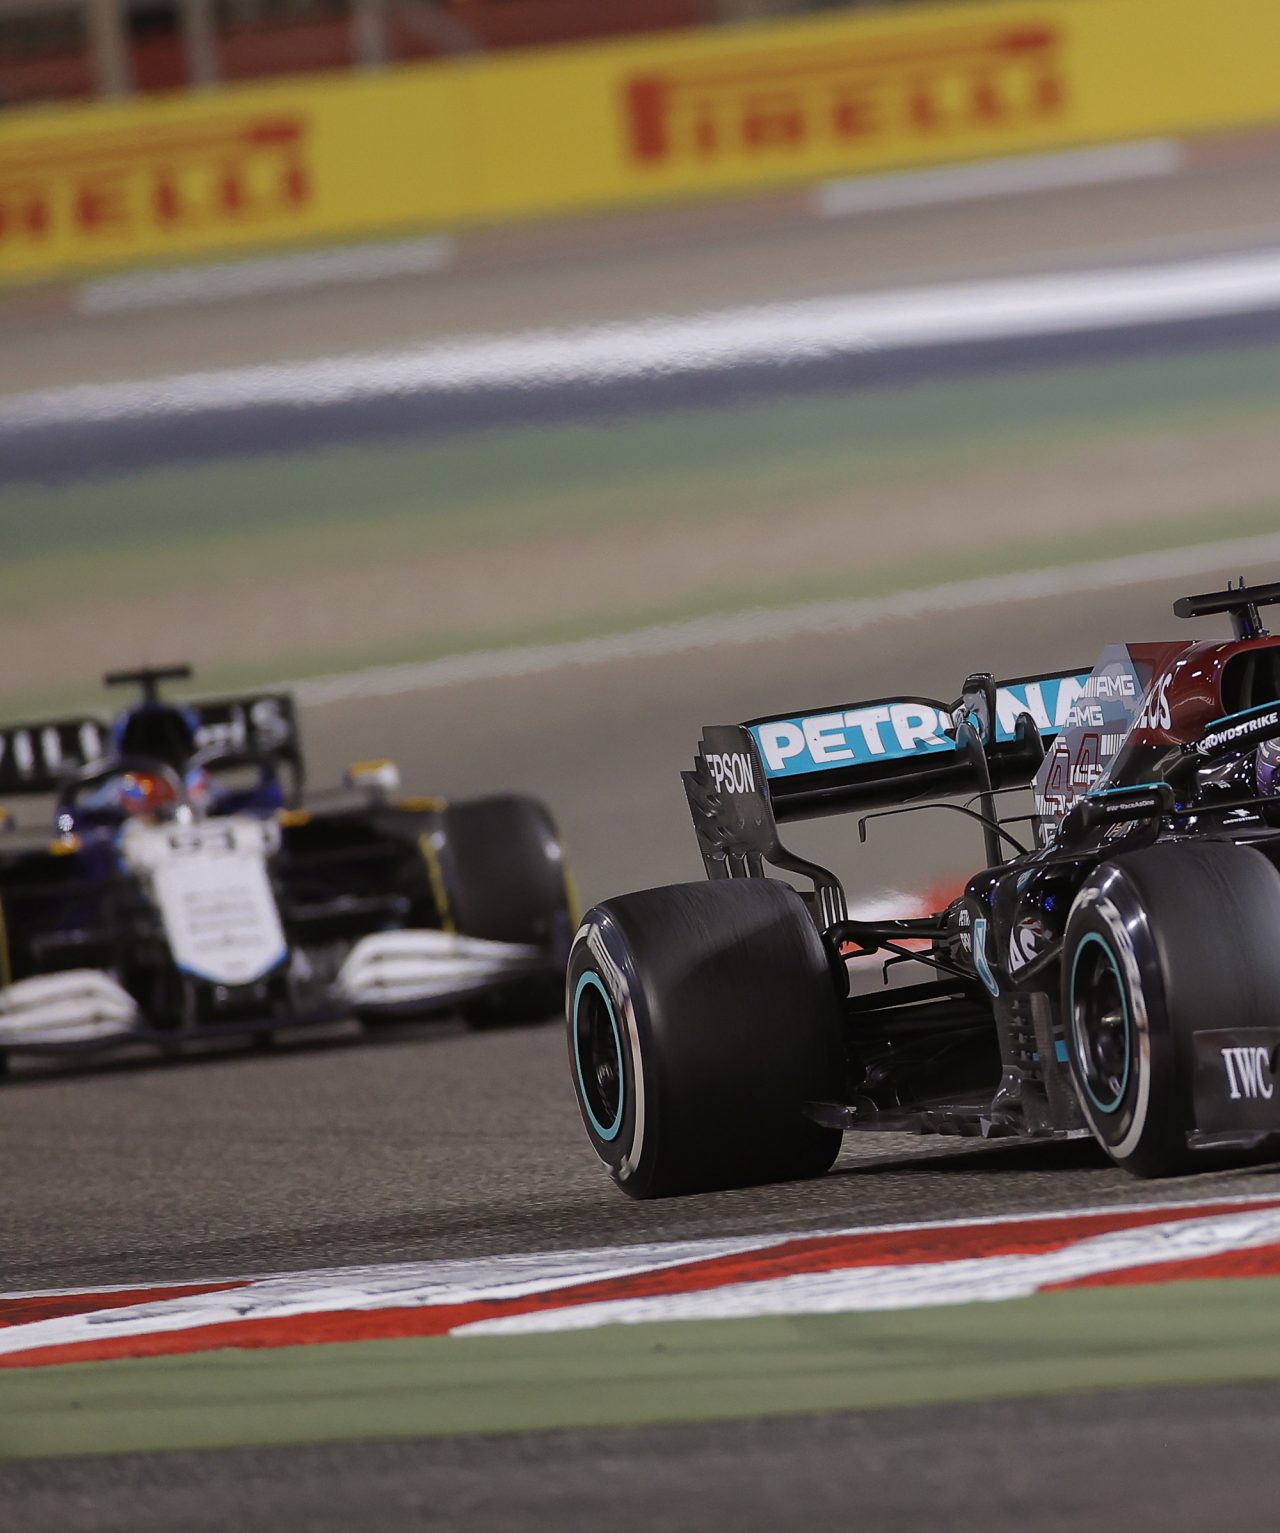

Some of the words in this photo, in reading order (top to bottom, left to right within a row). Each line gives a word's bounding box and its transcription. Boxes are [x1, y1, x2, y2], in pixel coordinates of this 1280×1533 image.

[622, 24, 1060, 171] PIRELLI
[0, 112, 306, 242] RELLI
[1097, 675, 1135, 697] AMG
[1138, 673, 1171, 730] EOS
[1067, 705, 1104, 728] AMG
[1200, 712, 1279, 750] CROWDSTRIKE
[1221, 1047, 1273, 1099] IWC
